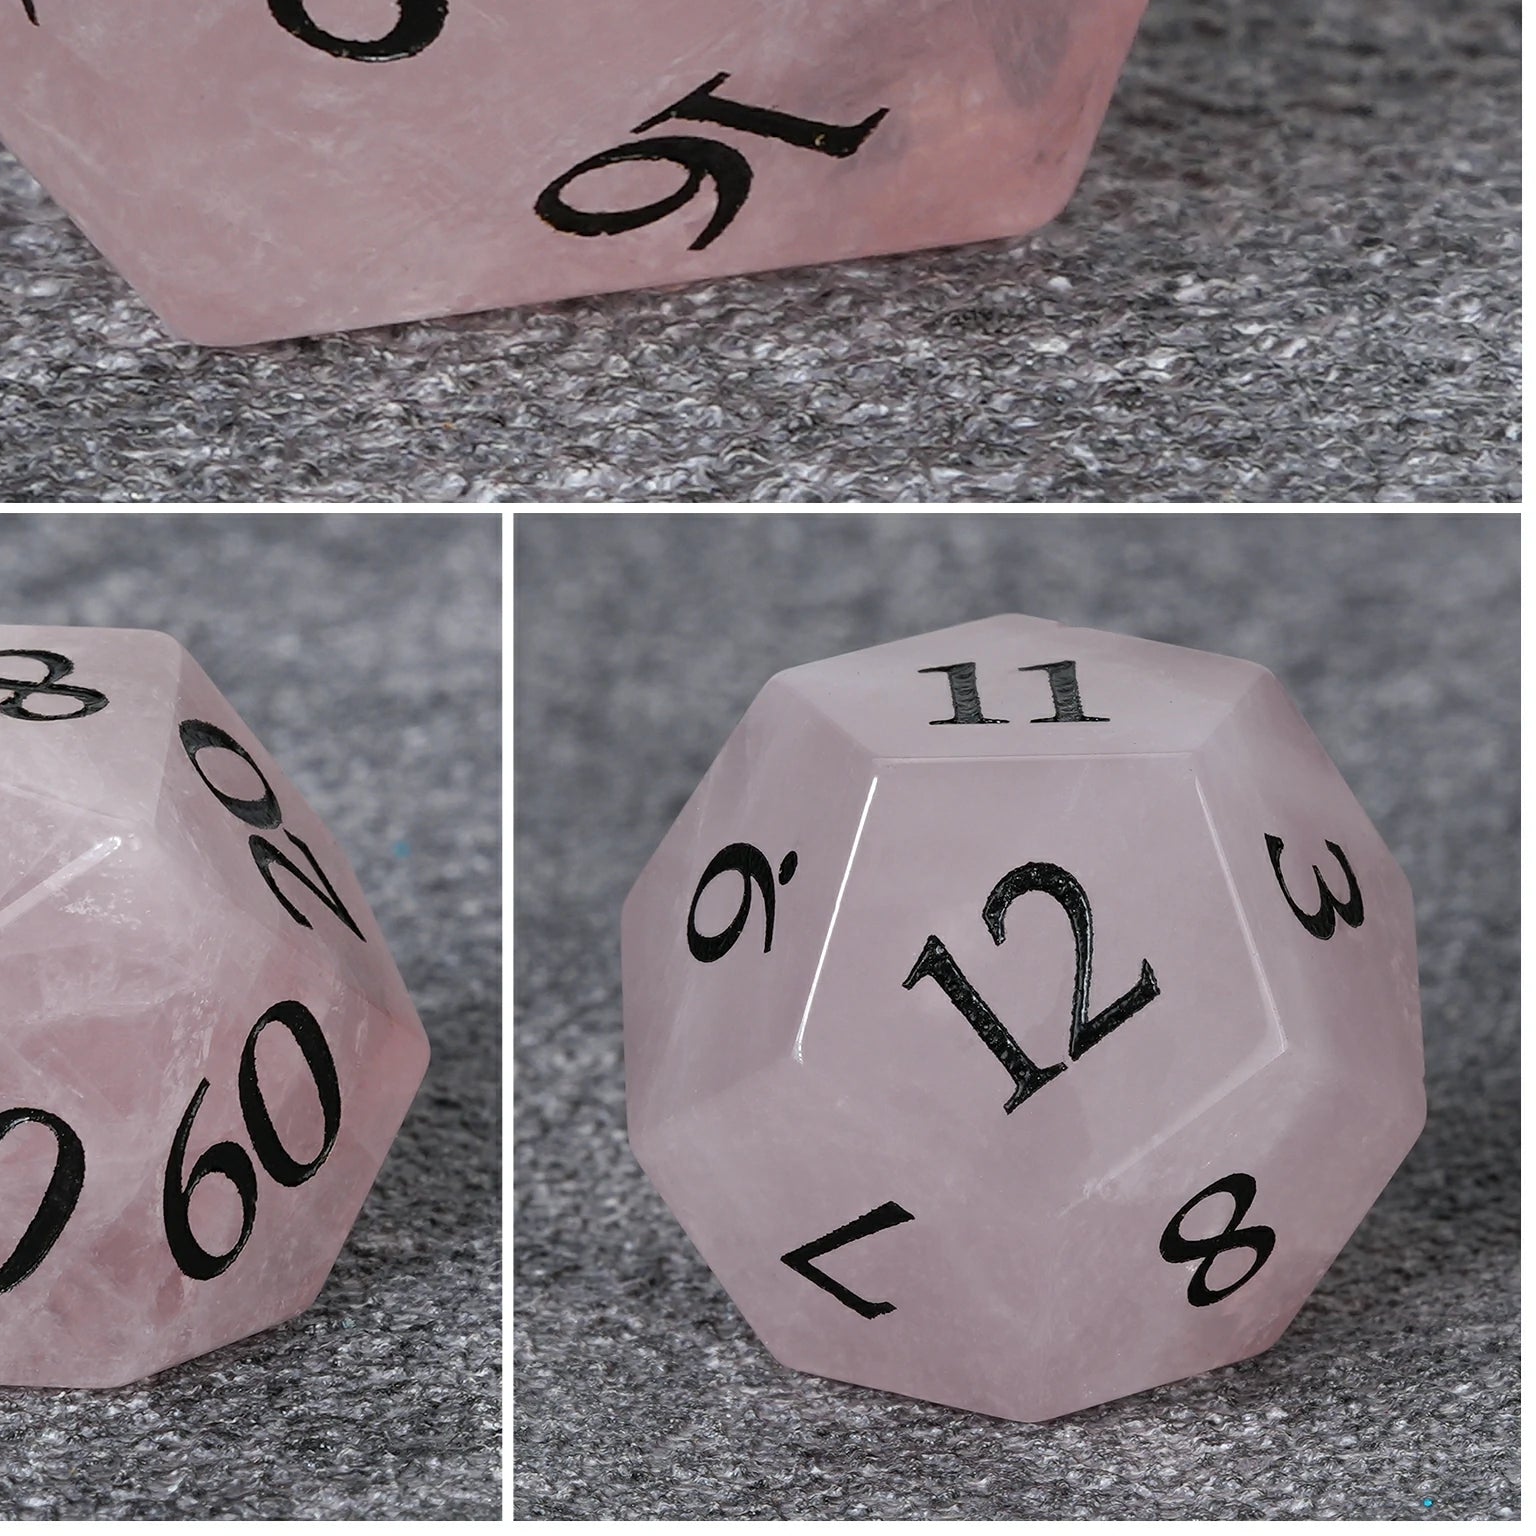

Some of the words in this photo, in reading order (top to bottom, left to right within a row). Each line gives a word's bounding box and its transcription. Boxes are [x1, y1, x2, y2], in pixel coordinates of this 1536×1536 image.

[534, 72, 890, 250] 16
[918, 660, 1111, 725] 11
[179, 719, 367, 942] 20
[1265, 833, 1364, 940] 3
[902, 862, 1160, 1115] 12
[163, 1000, 341, 1280] 60
[780, 1201, 915, 1320] 7
[1159, 1173, 1276, 1307] 8
